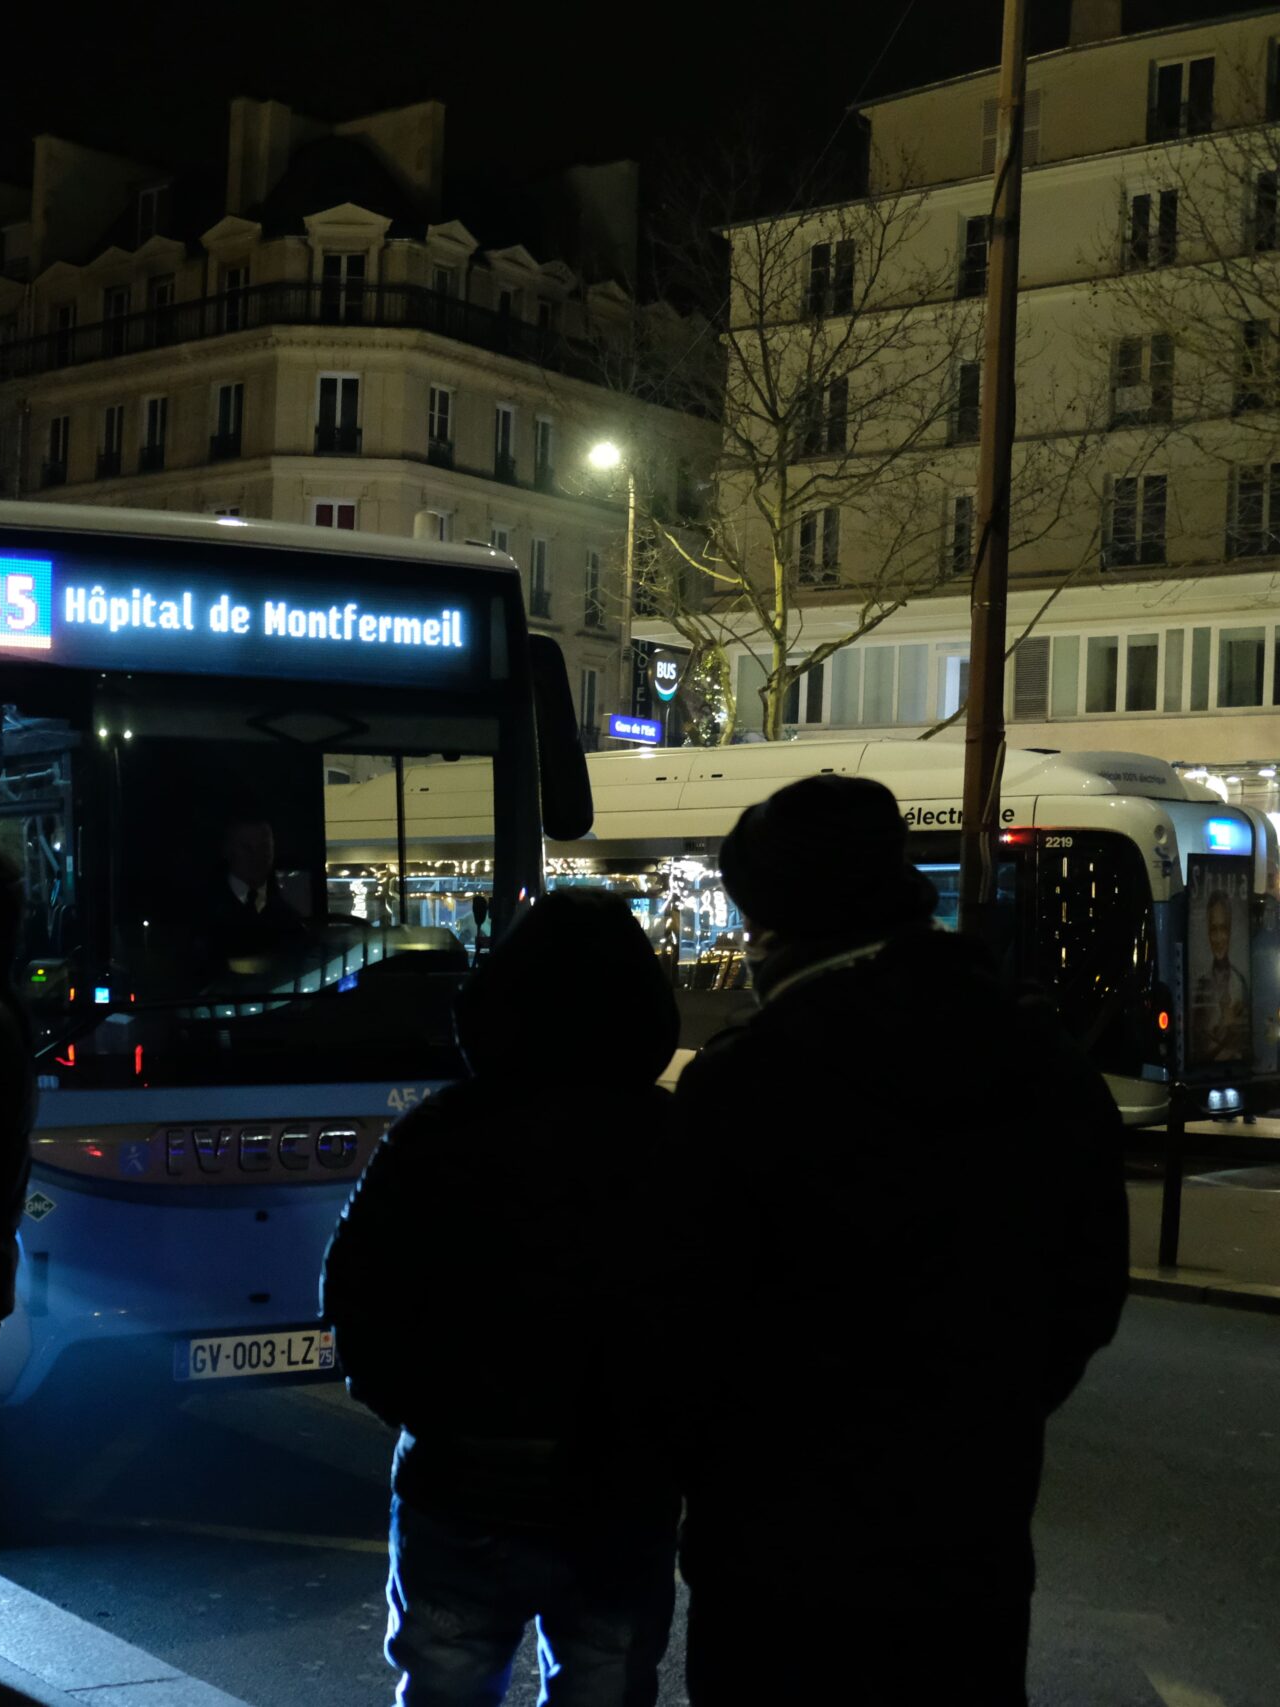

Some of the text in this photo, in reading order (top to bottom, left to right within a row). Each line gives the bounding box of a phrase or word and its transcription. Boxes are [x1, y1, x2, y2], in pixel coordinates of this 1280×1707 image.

[65, 585, 463, 648] Hôpital de Montfermeil
[656, 661, 677, 680] BUS
[615, 720, 631, 733] Gare
[631, 723, 641, 734] de
[904, 806, 1015, 826] électre
[1045, 836, 1073, 848] 2219
[166, 1122, 359, 1177] IVECO
[192, 1336, 315, 1374] GV-003-LZ
[320, 1350, 332, 1364] 75
